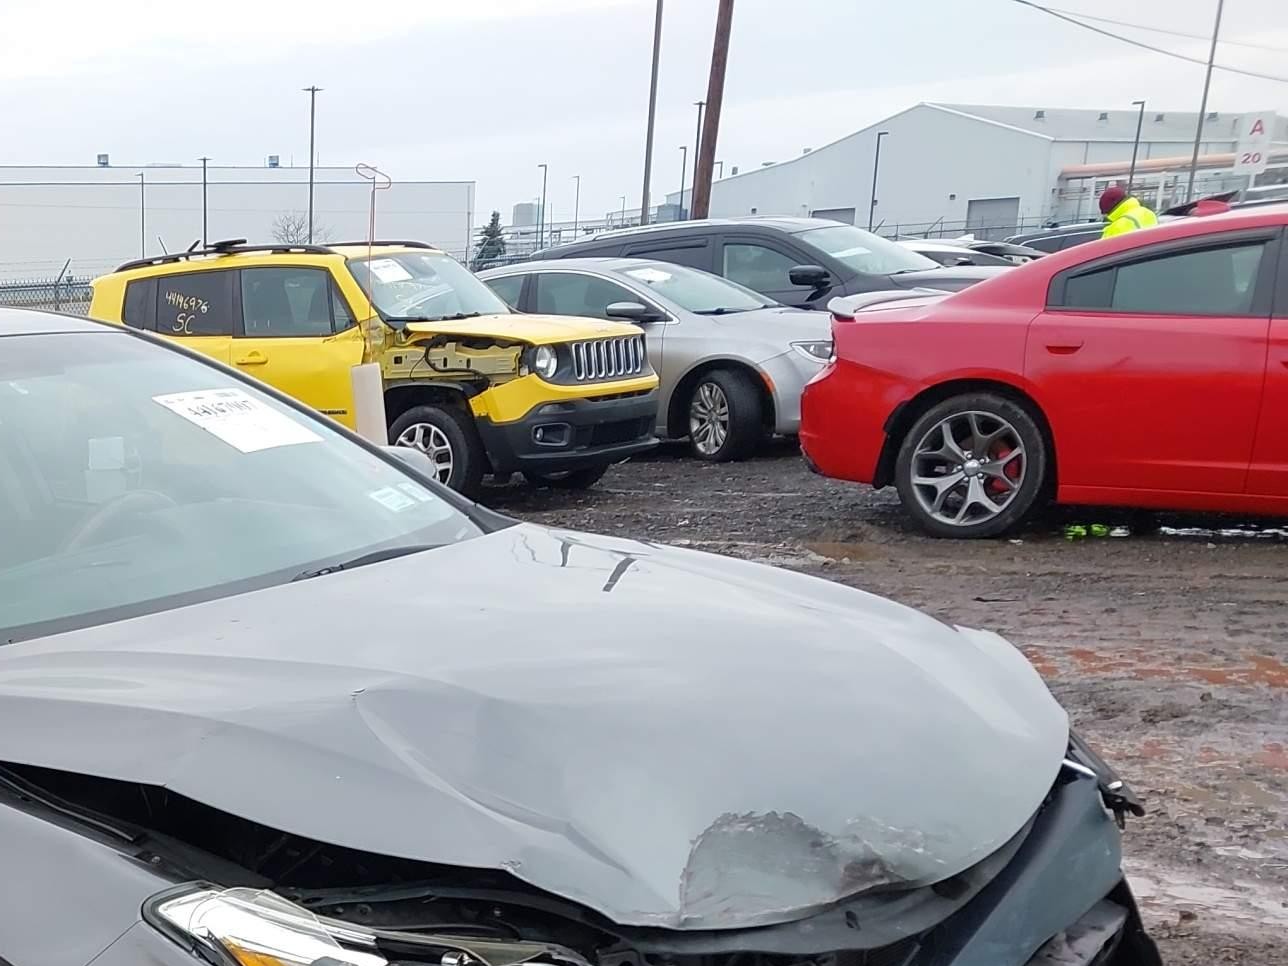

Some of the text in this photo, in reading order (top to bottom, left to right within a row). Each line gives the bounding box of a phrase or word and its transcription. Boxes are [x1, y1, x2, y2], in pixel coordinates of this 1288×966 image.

[1249, 119, 1265, 136] A
[1241, 152, 1262, 164] 20
[172, 312, 196, 335] SC
